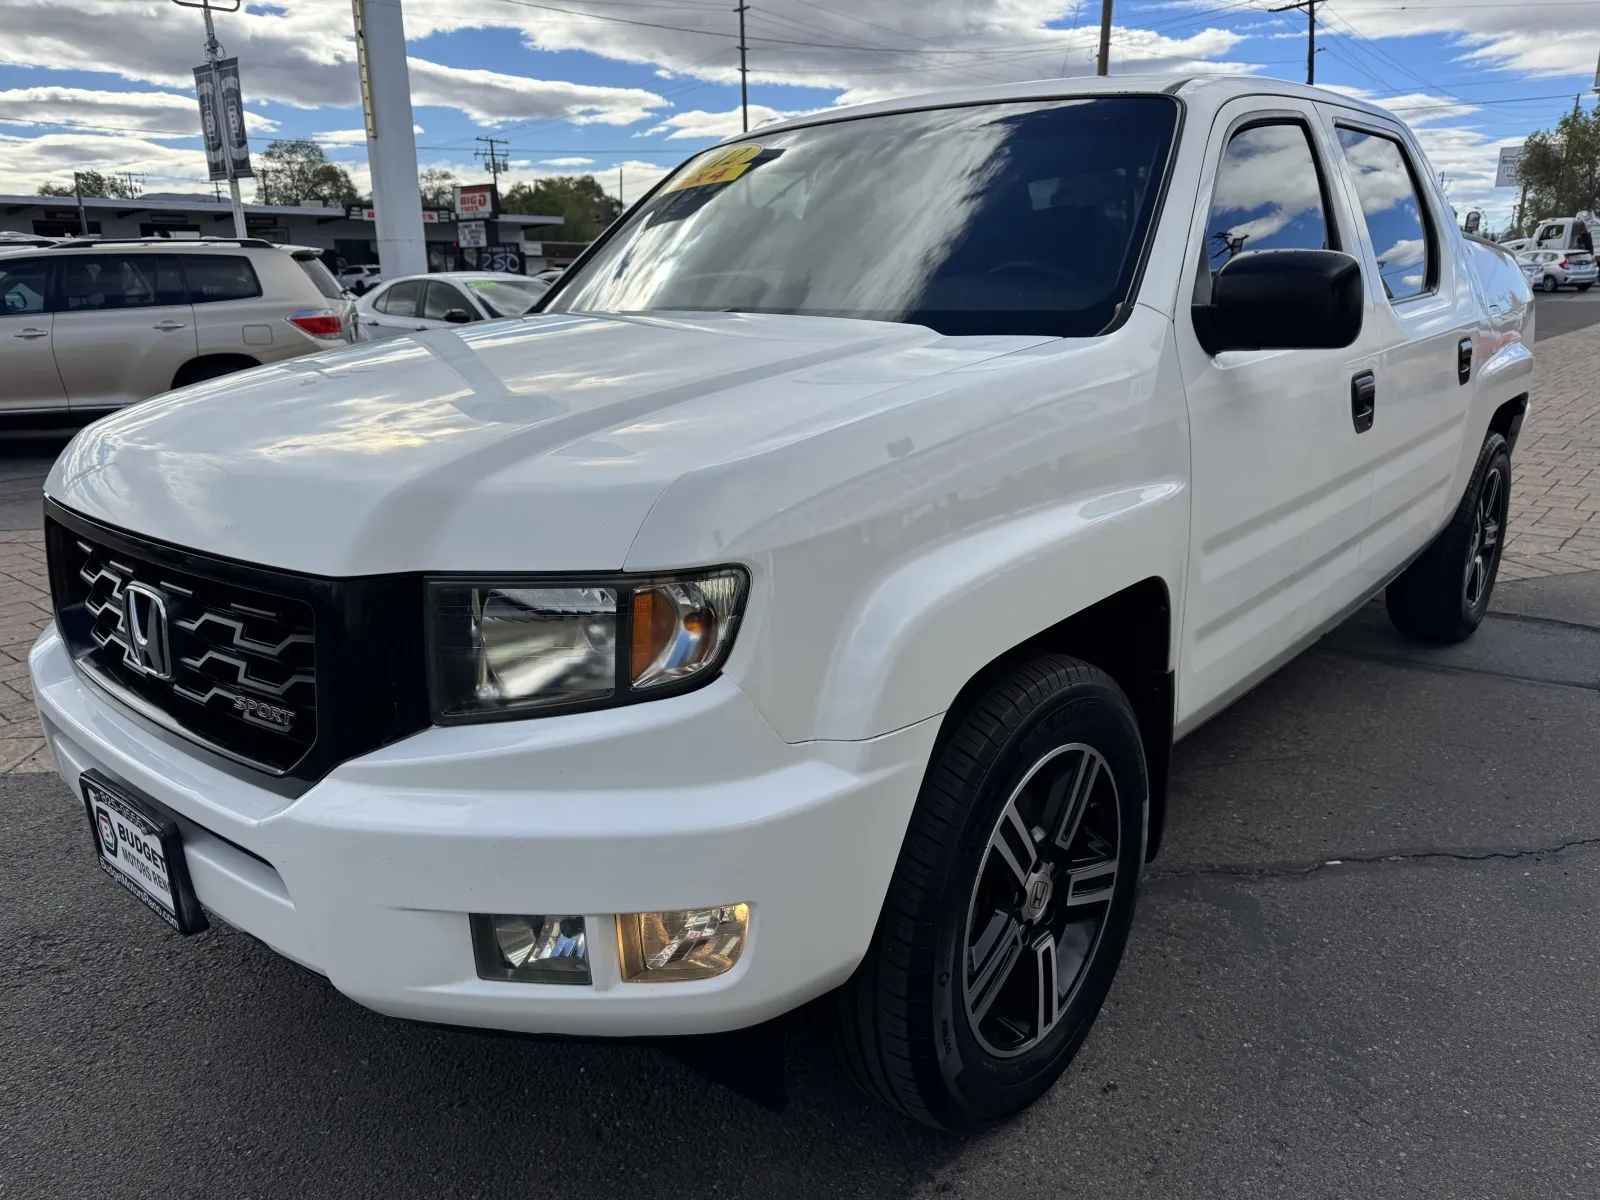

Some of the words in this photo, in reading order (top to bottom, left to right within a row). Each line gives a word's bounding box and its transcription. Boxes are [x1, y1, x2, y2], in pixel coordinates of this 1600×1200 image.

[482, 252, 520, 272] 250
[233, 695, 295, 725] SPORT
[117, 821, 167, 873] BUDGET
[121, 846, 152, 882] MOTORS
